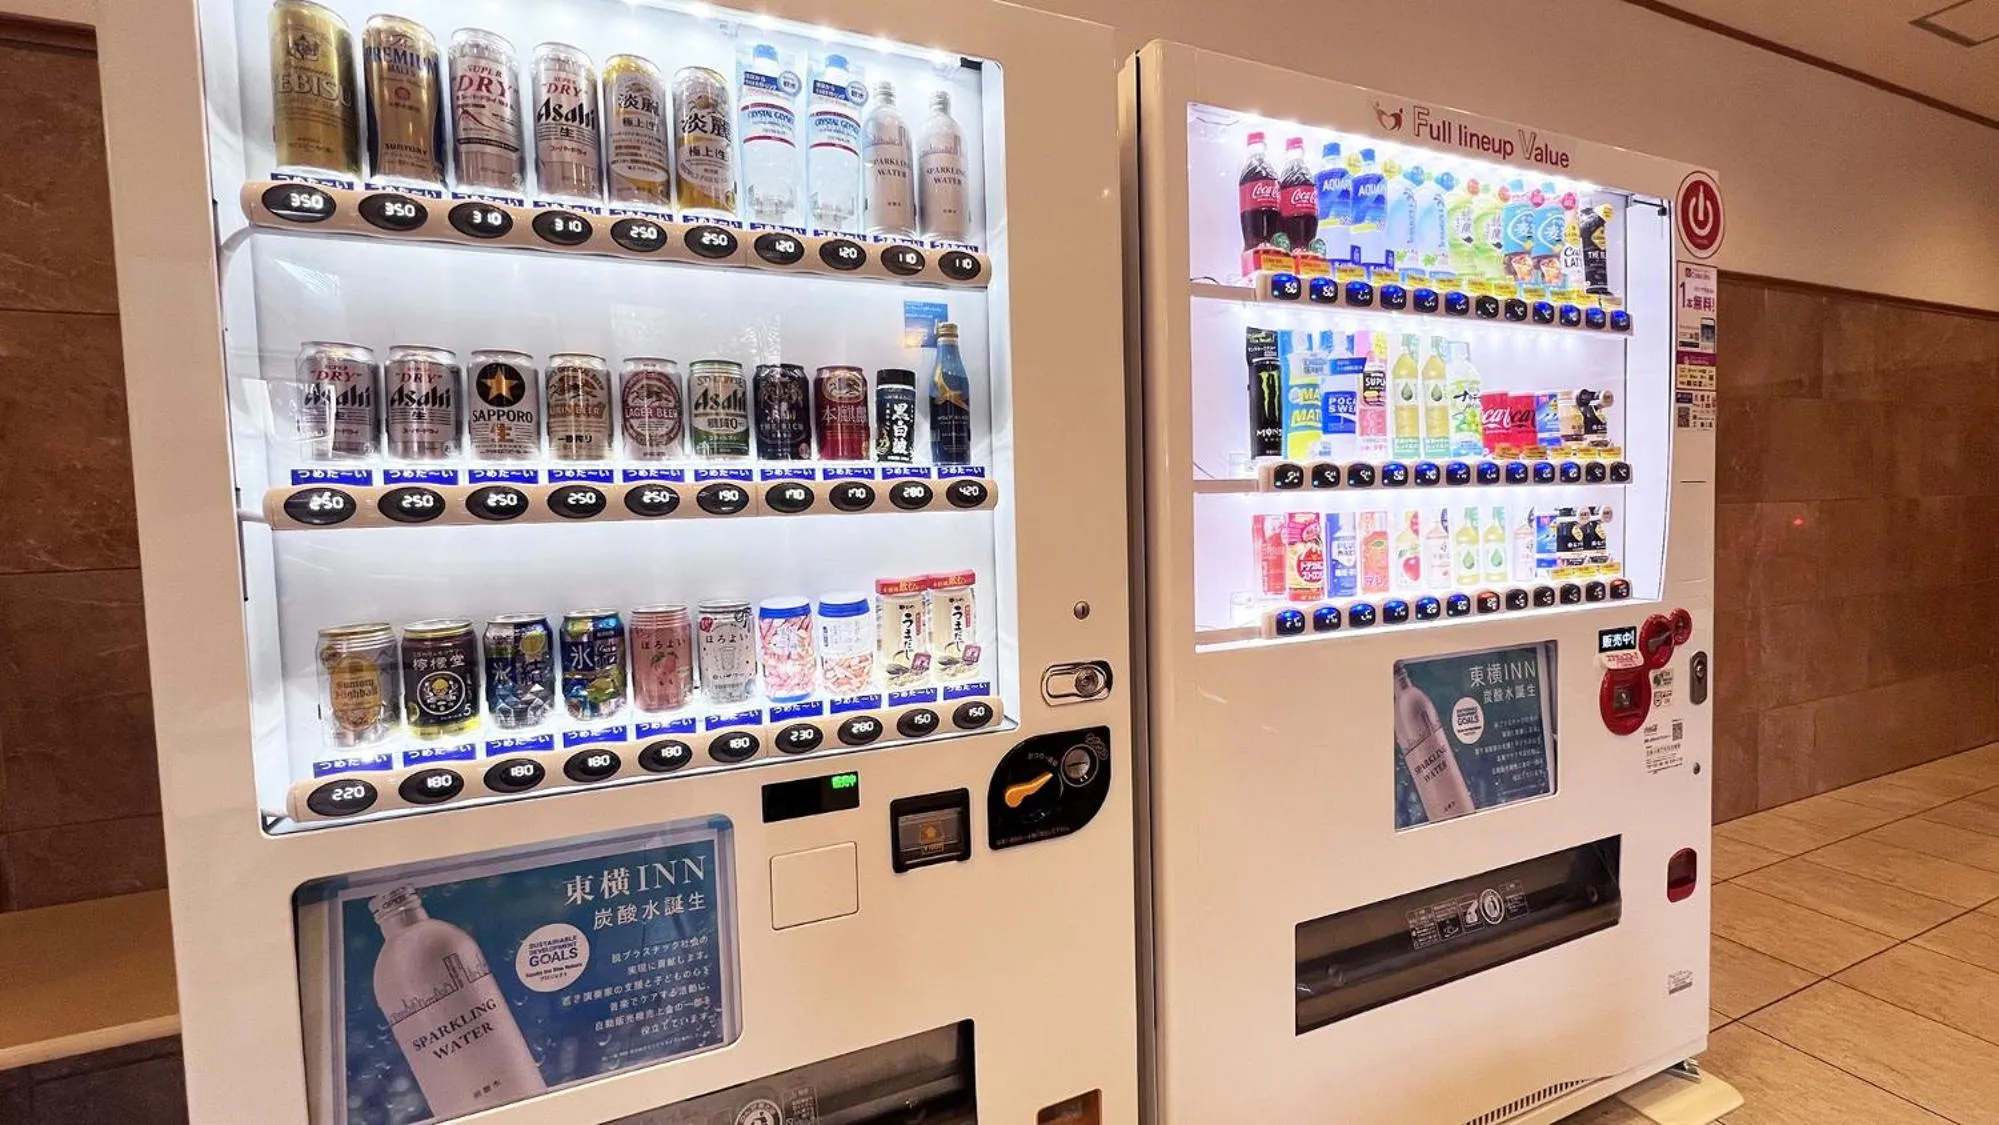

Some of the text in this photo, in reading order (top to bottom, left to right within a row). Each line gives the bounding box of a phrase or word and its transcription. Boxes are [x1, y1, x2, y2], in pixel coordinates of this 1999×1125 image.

[1413, 105, 1570, 168] Full lineup Value
[289, 193, 324, 210] 350
[384, 201, 416, 218] 350
[472, 211, 502, 226] 310
[554, 218, 582, 233] 310
[629, 226, 657, 240] 250
[701, 231, 729, 246] 250
[775, 241, 795, 253] 120
[838, 247, 858, 259] 120
[899, 253, 917, 264] 110
[955, 258, 973, 270] 110
[390, 384, 451, 409] Asahi
[472, 408, 534, 425] SAPPORO
[625, 406, 680, 419] LAGER BEER
[489, 422, 514, 443] 生
[567, 491, 596, 505] 250
[642, 490, 669, 503] 250
[718, 489, 739, 502] 190
[902, 486, 925, 498] 280
[958, 485, 979, 496] 420
[309, 492, 344, 510] 250
[402, 494, 434, 508] 250
[486, 492, 518, 507] 250
[1602, 632, 1634, 649] 販売中
[1469, 660, 1537, 688] 東横INN
[564, 855, 707, 905] 東横INN
[593, 892, 707, 931] 炭酸水誕生
[529, 947, 578, 967] GOALS
[412, 998, 497, 1052] SPARKLING
[432, 1021, 495, 1061] WATER
